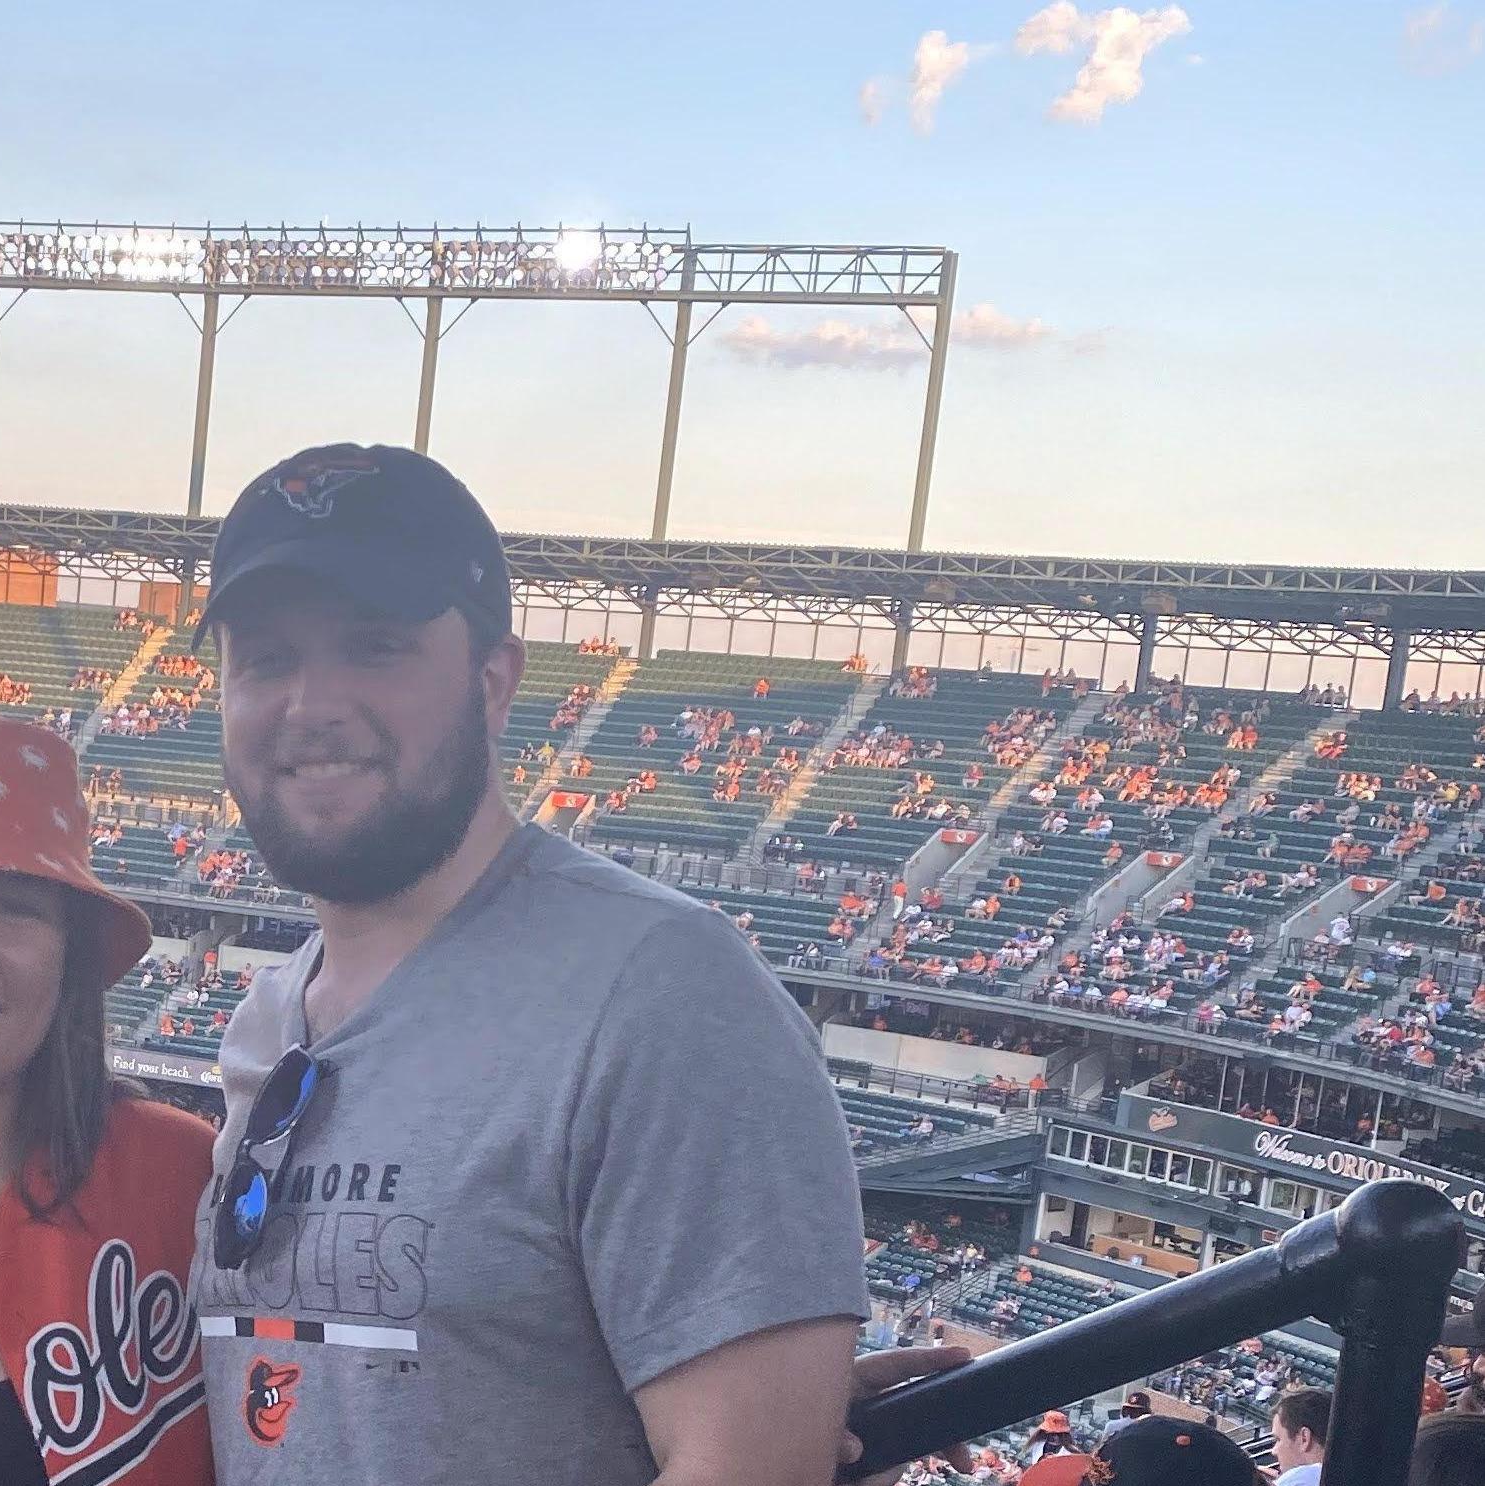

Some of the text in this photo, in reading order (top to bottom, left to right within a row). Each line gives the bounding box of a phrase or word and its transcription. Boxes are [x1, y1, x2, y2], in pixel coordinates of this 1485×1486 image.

[113, 1056, 136, 1070] Find
[137, 1063, 159, 1075] your
[1254, 1131, 1313, 1168] Welcome
[1313, 1154, 1327, 1170] to
